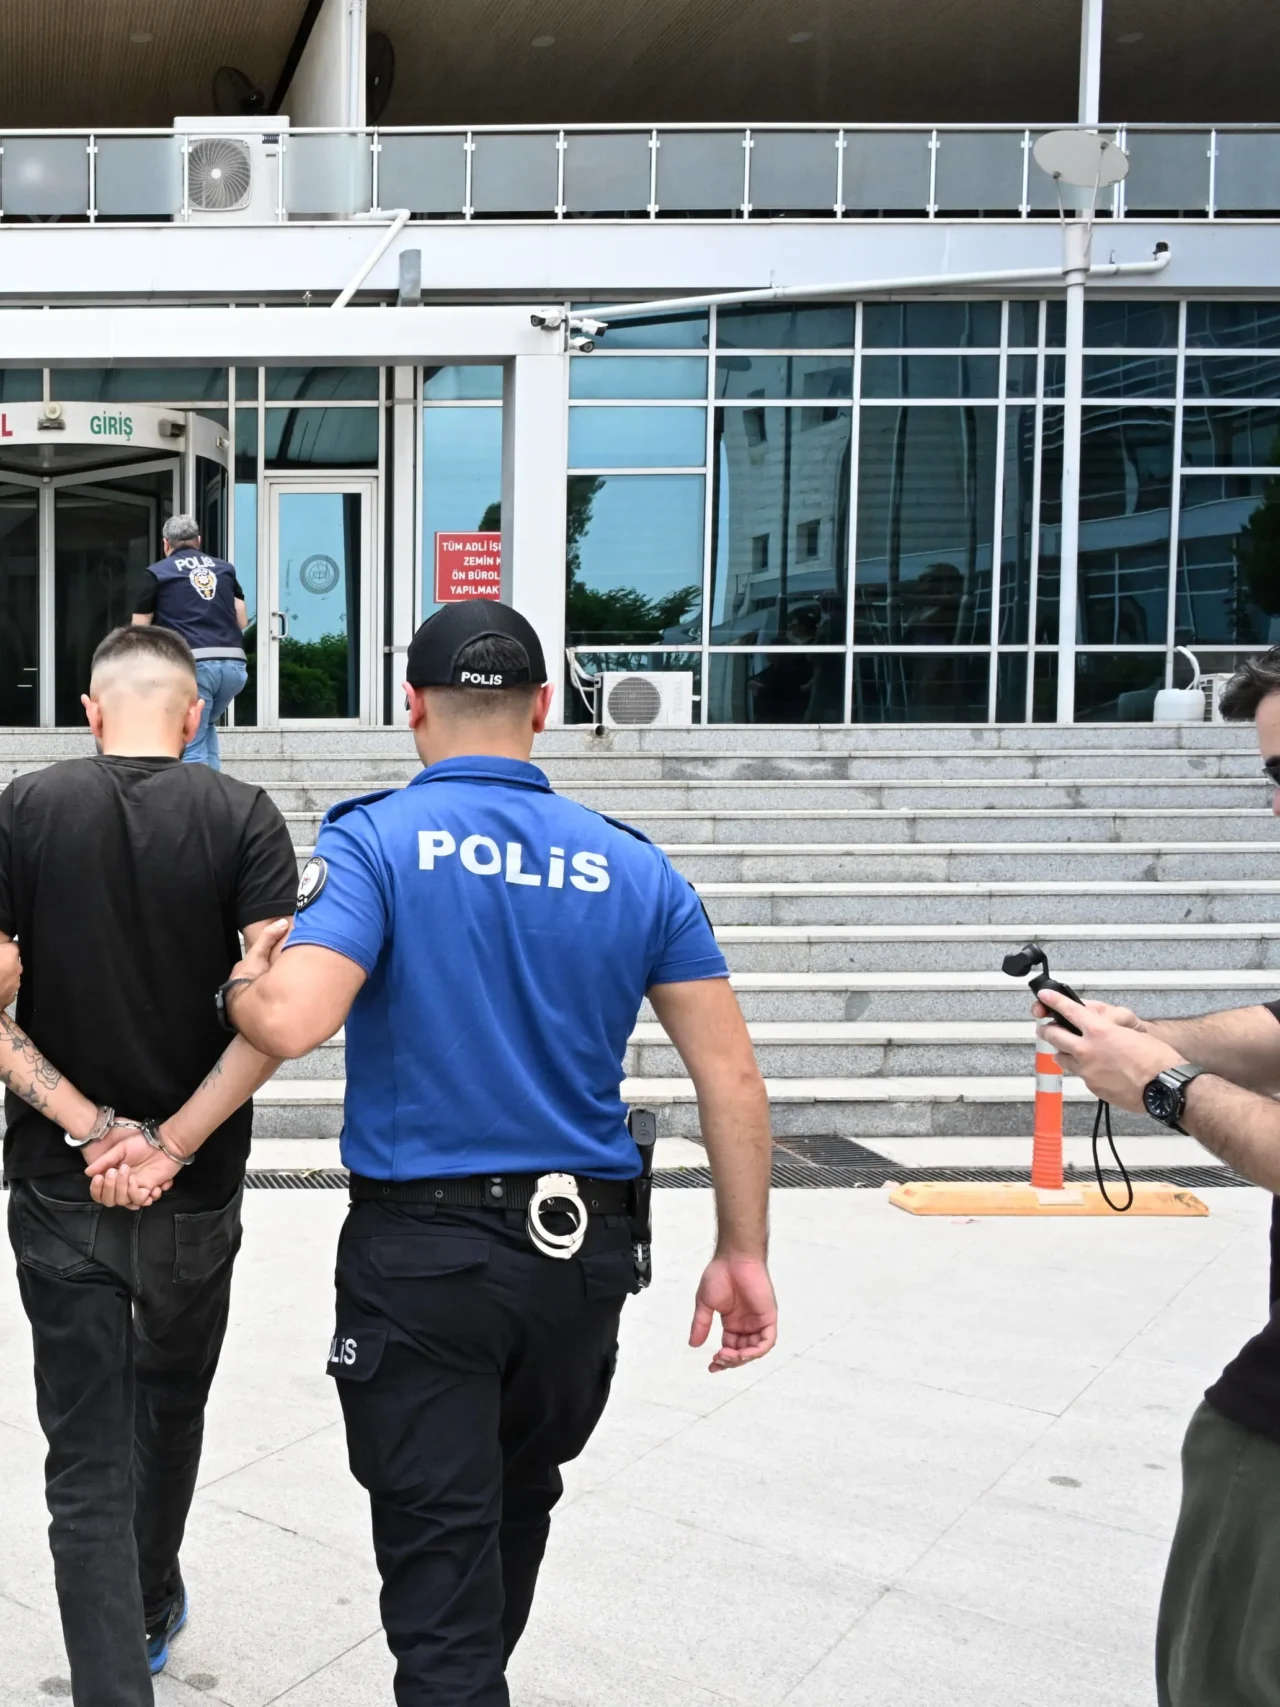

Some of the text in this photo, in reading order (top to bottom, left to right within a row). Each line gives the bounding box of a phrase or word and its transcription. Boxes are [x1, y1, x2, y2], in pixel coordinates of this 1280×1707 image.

[90, 411, 133, 441] GİRİŞ
[442, 540, 463, 551] TÜM
[465, 540, 487, 551] ADLİ
[463, 555, 494, 566] ZEMİN
[452, 569, 465, 580] ÖN
